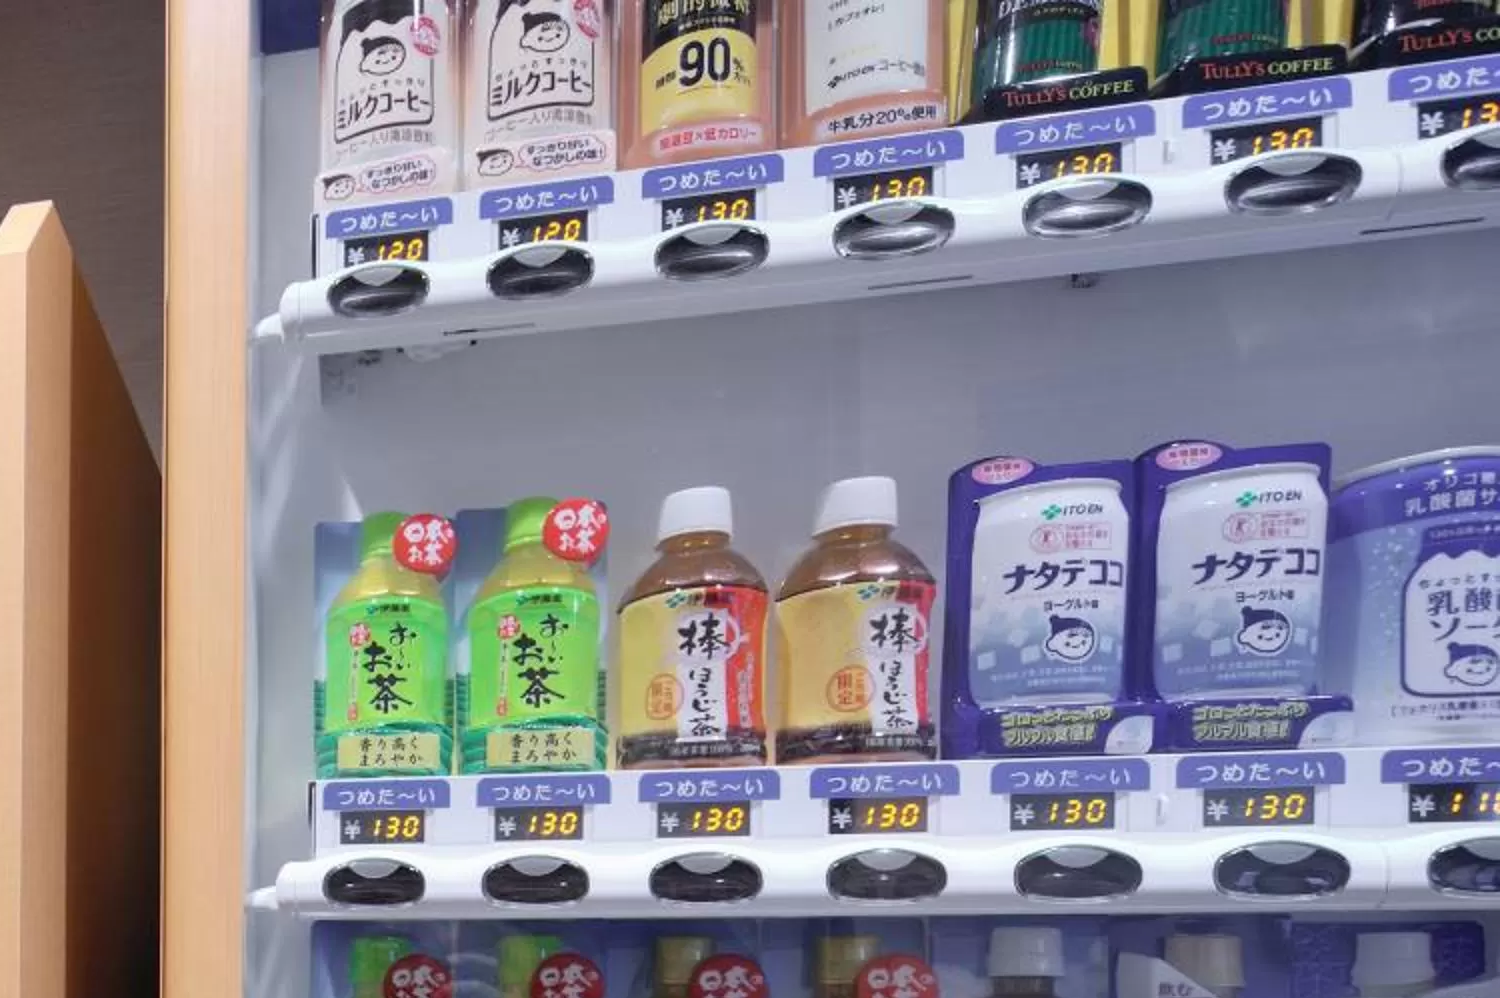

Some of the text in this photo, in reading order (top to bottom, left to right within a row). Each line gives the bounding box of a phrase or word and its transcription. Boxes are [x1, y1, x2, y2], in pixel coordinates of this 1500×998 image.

[679, 36, 732, 87] 90
[1267, 57, 1334, 76] COFFEE
[490, 68, 592, 106] ミルクコーヒー
[1069, 79, 1135, 100] COFFEE
[337, 88, 432, 129] ミルクコーヒー
[1203, 88, 1332, 120] つめた〜い
[827, 104, 938, 133] 牛乳分20%使用
[1014, 115, 1136, 145] つめた〜い
[1421, 111, 1444, 135] ¥
[830, 140, 946, 170] つめた〜い
[1213, 139, 1236, 162] ¥
[659, 163, 768, 191] つめた〜い
[1019, 162, 1041, 185] ¥
[494, 185, 598, 211] つめた〜い
[837, 175, 926, 208] ¥ 130
[340, 207, 439, 232] つめた〜い
[664, 197, 750, 229] ¥ 130
[501, 219, 582, 248] ¥ 120
[346, 238, 424, 266] ¥ 120
[1002, 558, 1125, 595] ナタデココ
[1192, 547, 1322, 585] ナタデココ
[1427, 586, 1500, 617] 乳酸
[362, 641, 414, 714] お茶
[512, 632, 567, 708] お茶
[359, 734, 419, 750] 香り高く
[510, 732, 573, 748] 香り高く
[358, 751, 424, 767] まろやか
[510, 749, 577, 764] まろやか
[827, 772, 942, 793] つめた〜い
[1009, 769, 1132, 789] つめた〜い
[1195, 760, 1326, 781] つめた〜い
[338, 787, 435, 806] つめた〜い
[492, 782, 596, 801] つめた〜い
[655, 776, 764, 797] つめた〜い
[660, 807, 745, 832] ¥ 130
[833, 803, 919, 829] ¥ 130
[1014, 799, 1108, 825] ¥ 130
[1207, 794, 1307, 821] ¥ 130
[344, 816, 420, 839] ¥ 130
[498, 812, 578, 836] ¥ 130
